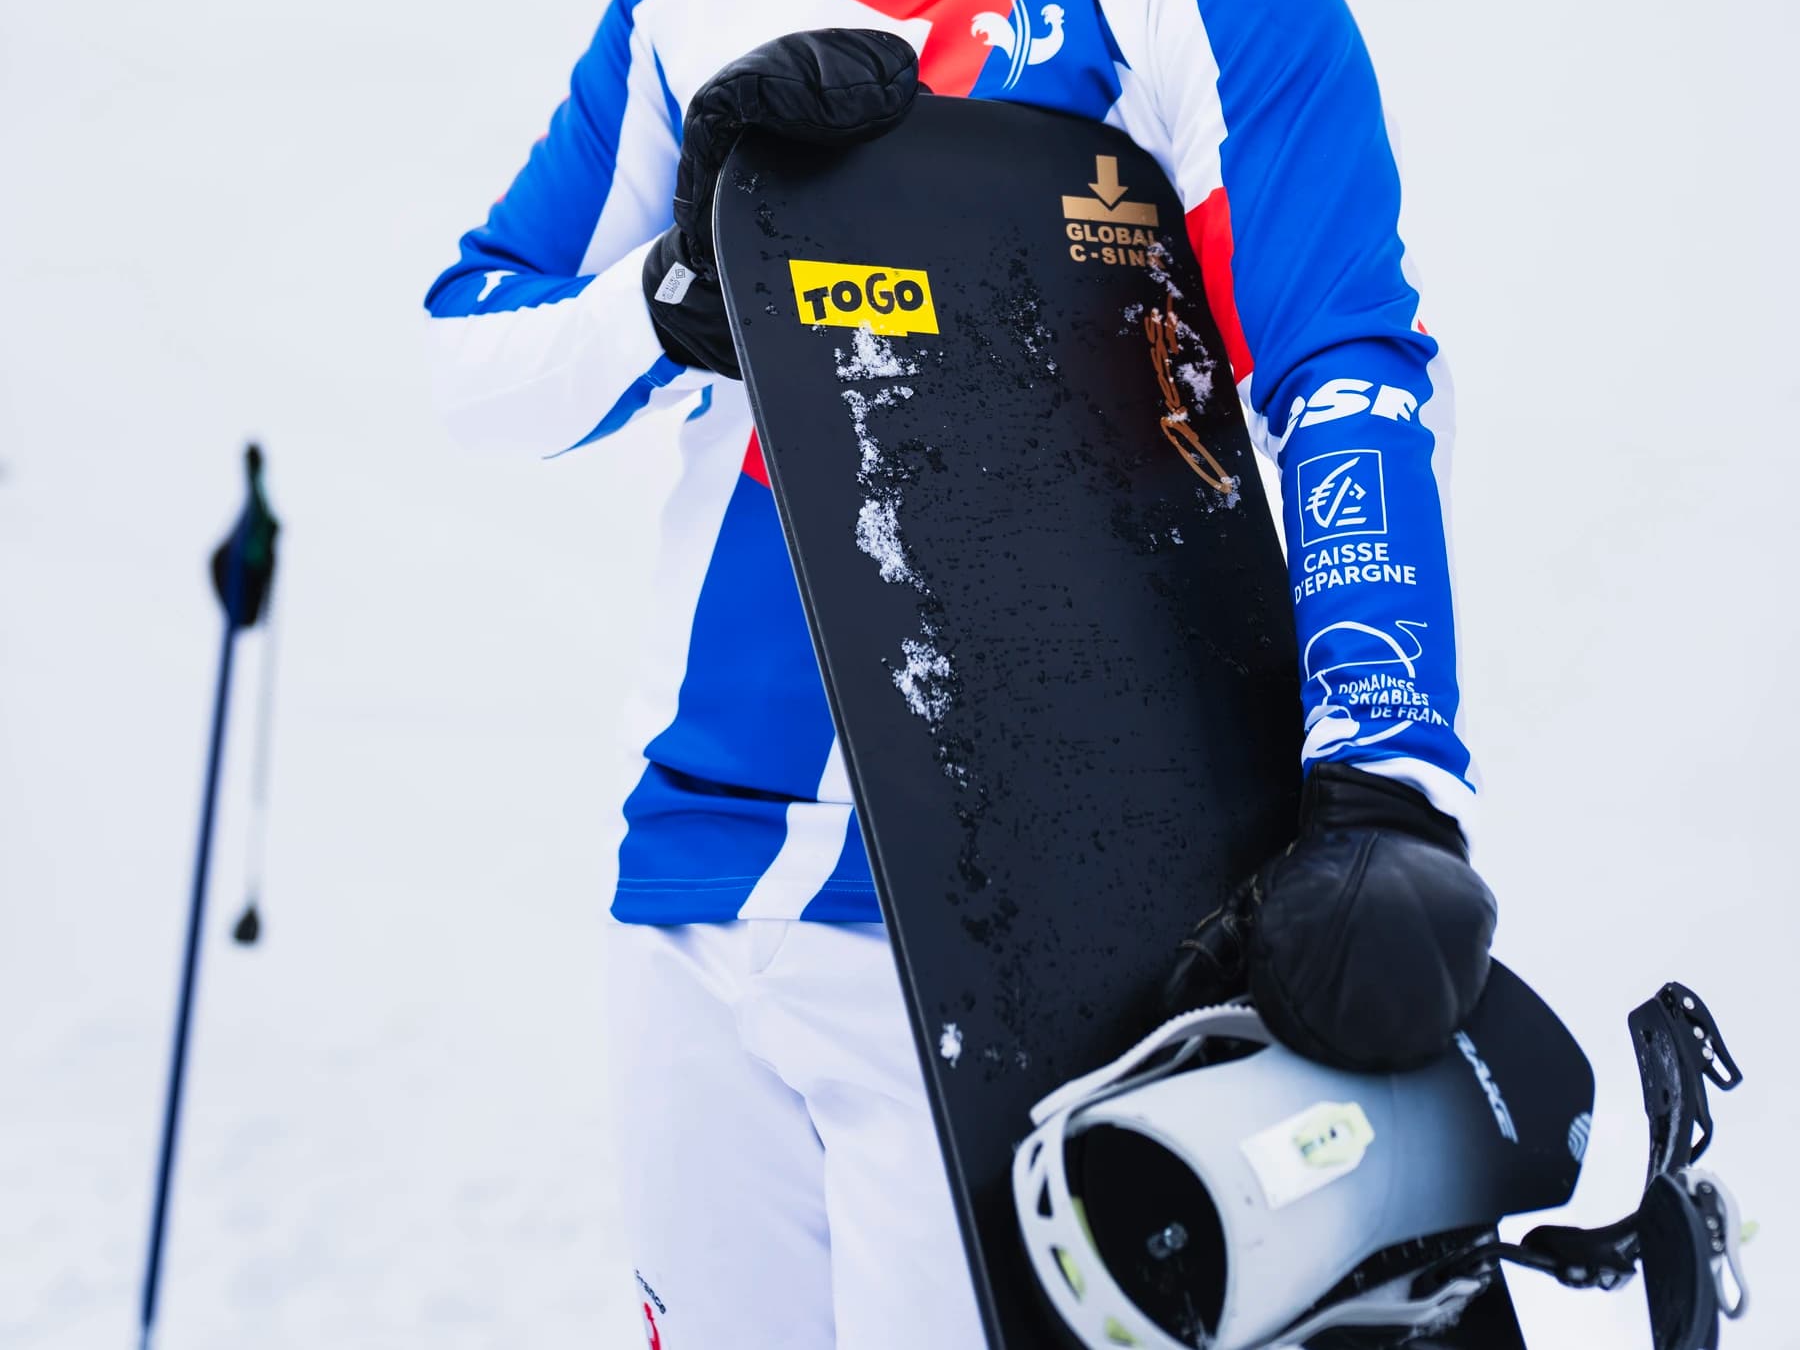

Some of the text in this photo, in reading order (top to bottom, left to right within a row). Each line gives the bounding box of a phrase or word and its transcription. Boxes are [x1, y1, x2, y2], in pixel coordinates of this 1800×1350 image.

[802, 272, 925, 322] TOGO
[1303, 542, 1391, 574] CAISSE
[1294, 563, 1418, 606] D'EPARGNE
[1338, 673, 1415, 694] DOMAINES
[1348, 688, 1430, 707] SKIABLES
[1370, 705, 1450, 727] DE FRAN
